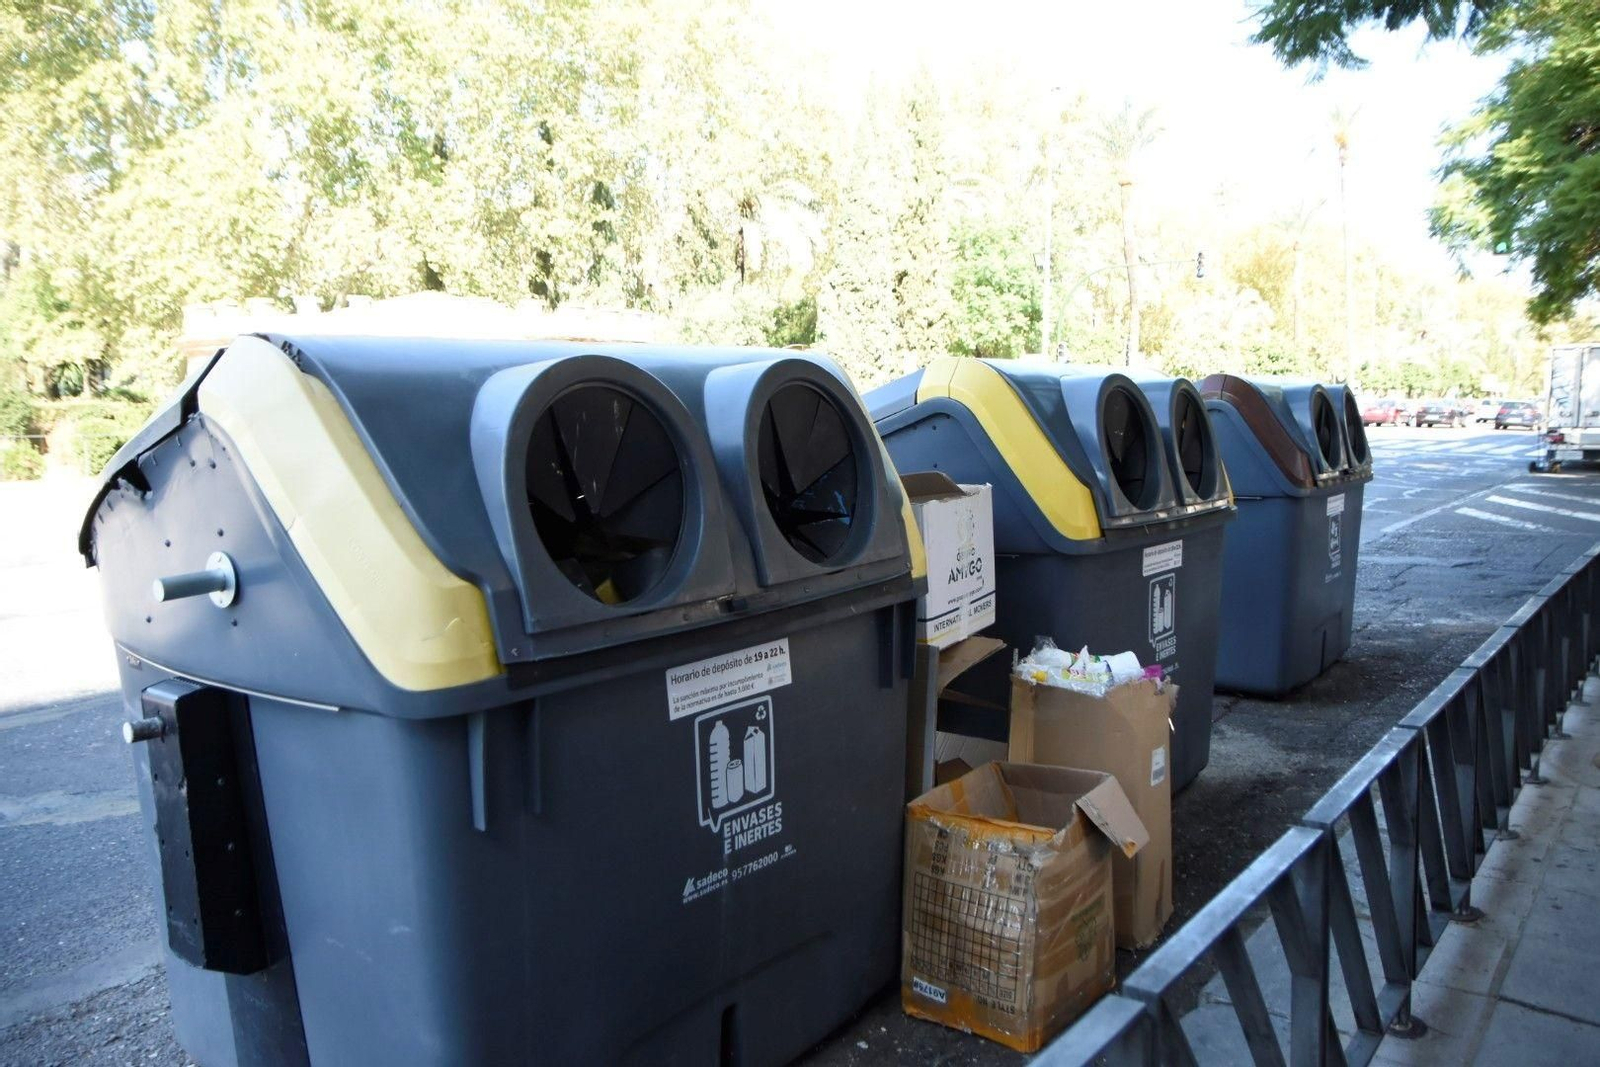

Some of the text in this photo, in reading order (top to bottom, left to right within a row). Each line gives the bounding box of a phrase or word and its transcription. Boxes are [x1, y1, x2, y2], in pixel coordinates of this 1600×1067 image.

[670, 645, 786, 686] Horario de depósito de 19 a 22 h.
[723, 801, 782, 838] ENVASES
[724, 818, 782, 854] E INERTES
[697, 868, 728, 889] sadeco
[731, 852, 779, 880] 957762000
